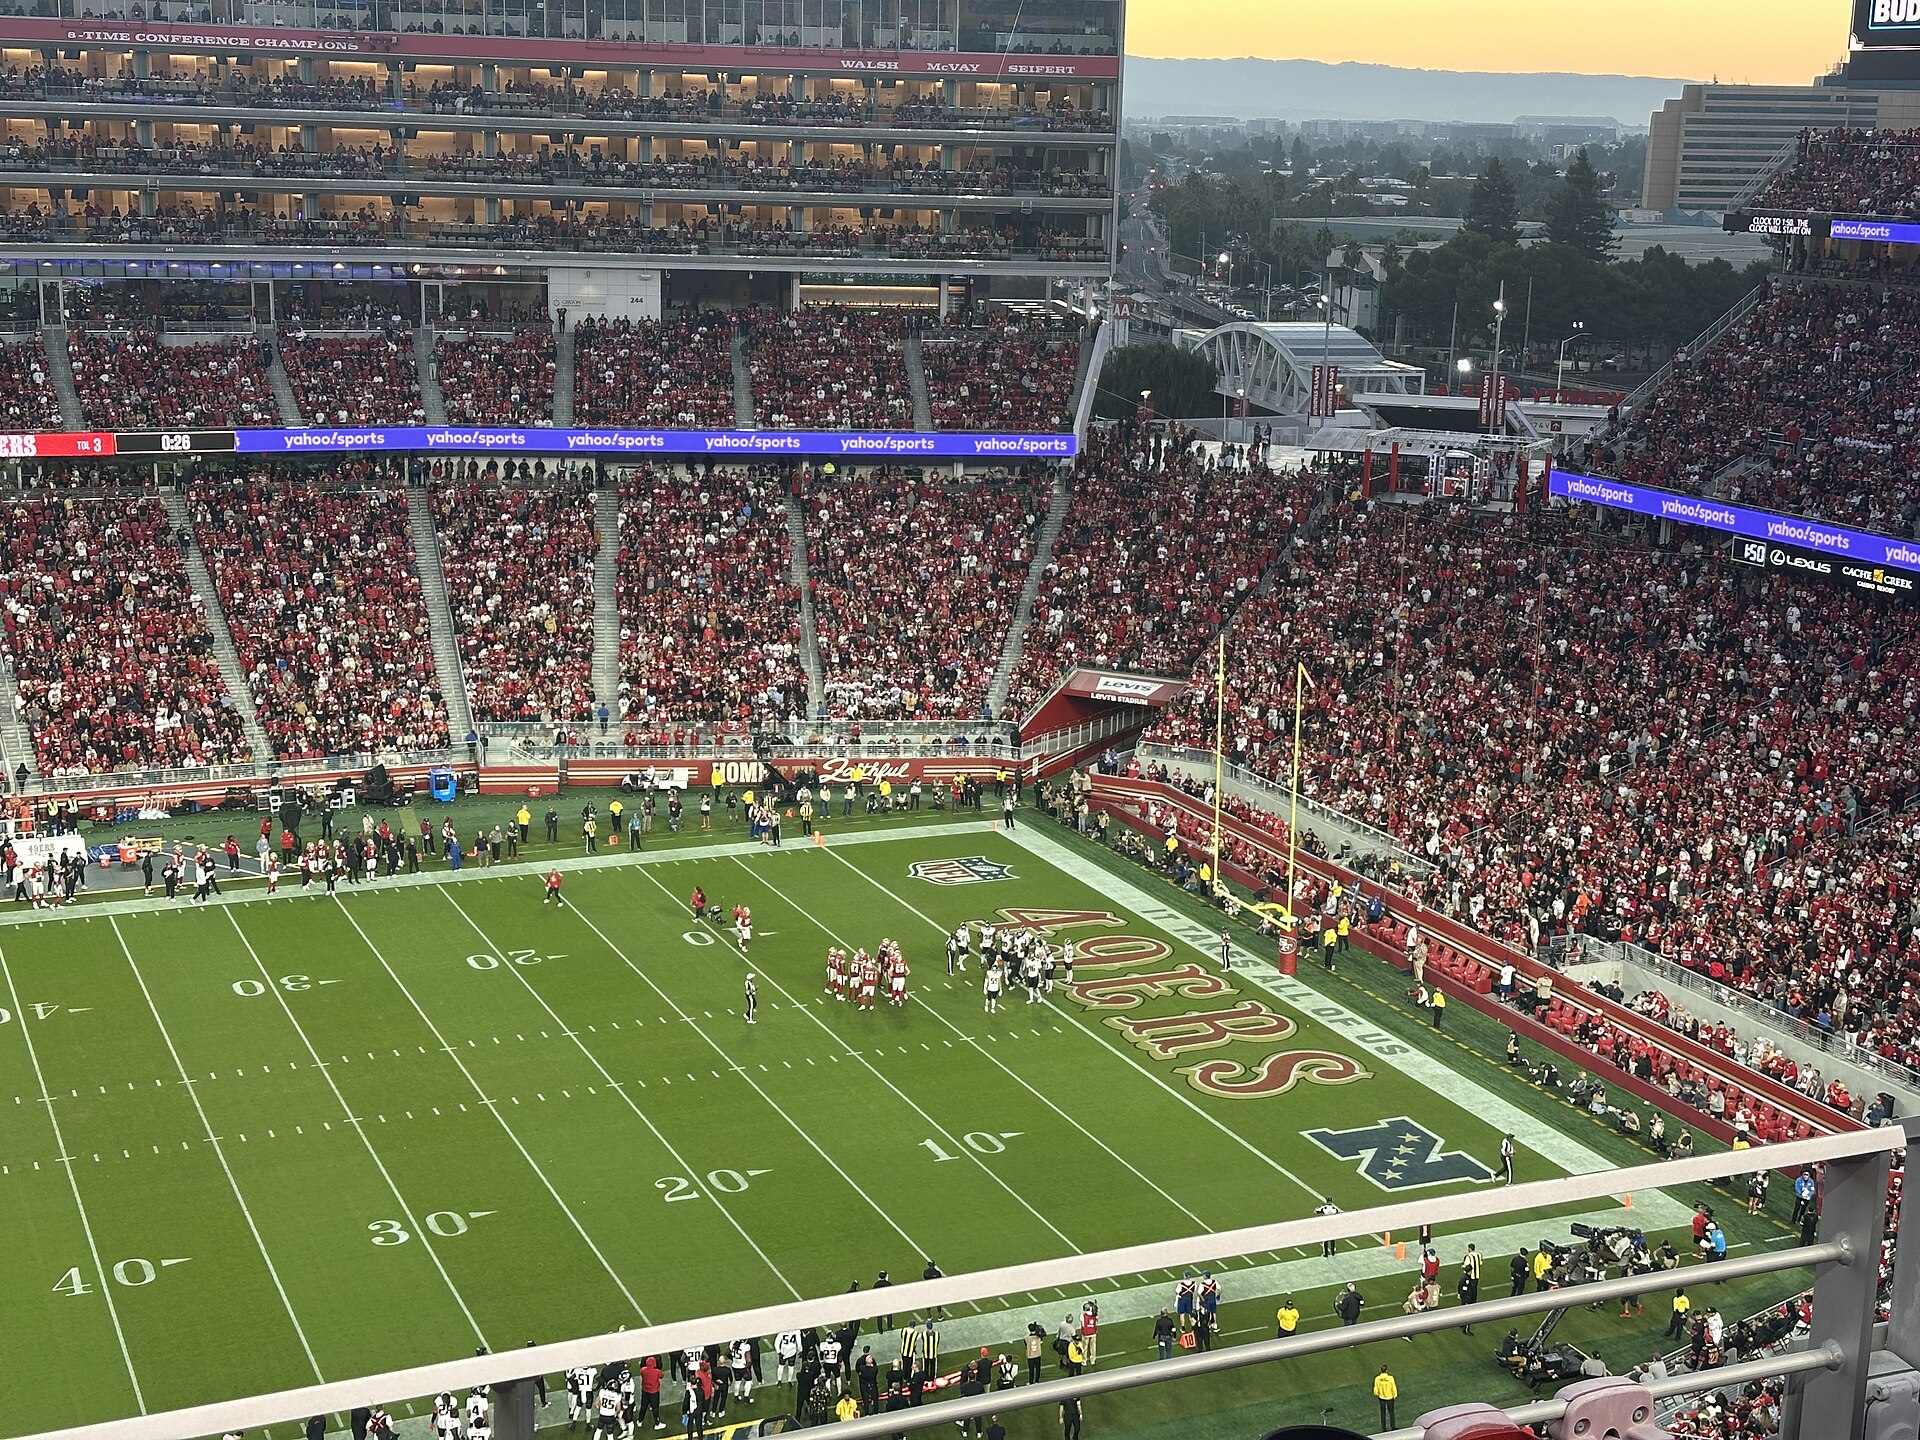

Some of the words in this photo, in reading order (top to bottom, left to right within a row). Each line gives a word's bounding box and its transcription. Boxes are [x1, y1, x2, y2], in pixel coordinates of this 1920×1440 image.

[1873, 0, 1920, 23] BUD
[67, 31, 131, 41] 8-TIME
[135, 33, 250, 46] CONFERENCE
[254, 38, 359, 51] CHAMPIONS
[840, 60, 899, 70] WALSH
[926, 62, 980, 72] McVAY
[1007, 64, 1076, 75] SEIFERT
[1752, 216, 1772, 226] CLOCK
[1772, 217, 1781, 226] TO
[1797, 218, 1809, 227] THE
[1749, 224, 1768, 233] CLOCK
[1768, 225, 1782, 234] WILL
[1782, 226, 1800, 235] START
[1800, 227, 1811, 236] ON
[1830, 223, 1890, 238] yahoo!sports
[76, 440, 90, 450] TOL
[93, 437, 102, 453] 3
[161, 434, 191, 450] 0:26
[284, 432, 385, 448] yahoo!sports
[426, 430, 526, 447] yahoo!sports
[567, 433, 665, 449] yahoo!sports
[705, 434, 801, 450] yahoo!sports
[841, 436, 935, 452] yahoo!sports
[974, 437, 1068, 453] yahoo!sports
[1567, 478, 1634, 504] yahoo!sports
[1662, 499, 1736, 525] yahoo!sports
[1767, 520, 1850, 549] yahoo!sports
[1786, 554, 1832, 574] LEXUS
[1842, 566, 1873, 581] CACHE
[1883, 575, 1913, 589] CREEK
[1117, 696, 1149, 706] STADIUM
[1141, 907, 1180, 923] IT
[1258, 973, 1315, 1004] ALL
[1311, 1005, 1359, 1028] OF
[1354, 1032, 1411, 1058] US
[918, 1131, 1006, 1163] 10
[654, 1168, 750, 1203] 20
[367, 1210, 469, 1247] 30
[51, 1258, 157, 1298] 40
[782, 1334, 797, 1345] 54
[1184, 1333, 1195, 1347] 10
[687, 1351, 701, 1362] 20
[824, 1349, 837, 1360] 23
[577, 1374, 590, 1386] 51
[472, 1405, 479, 1416] 4
[601, 1397, 615, 1410] 85
